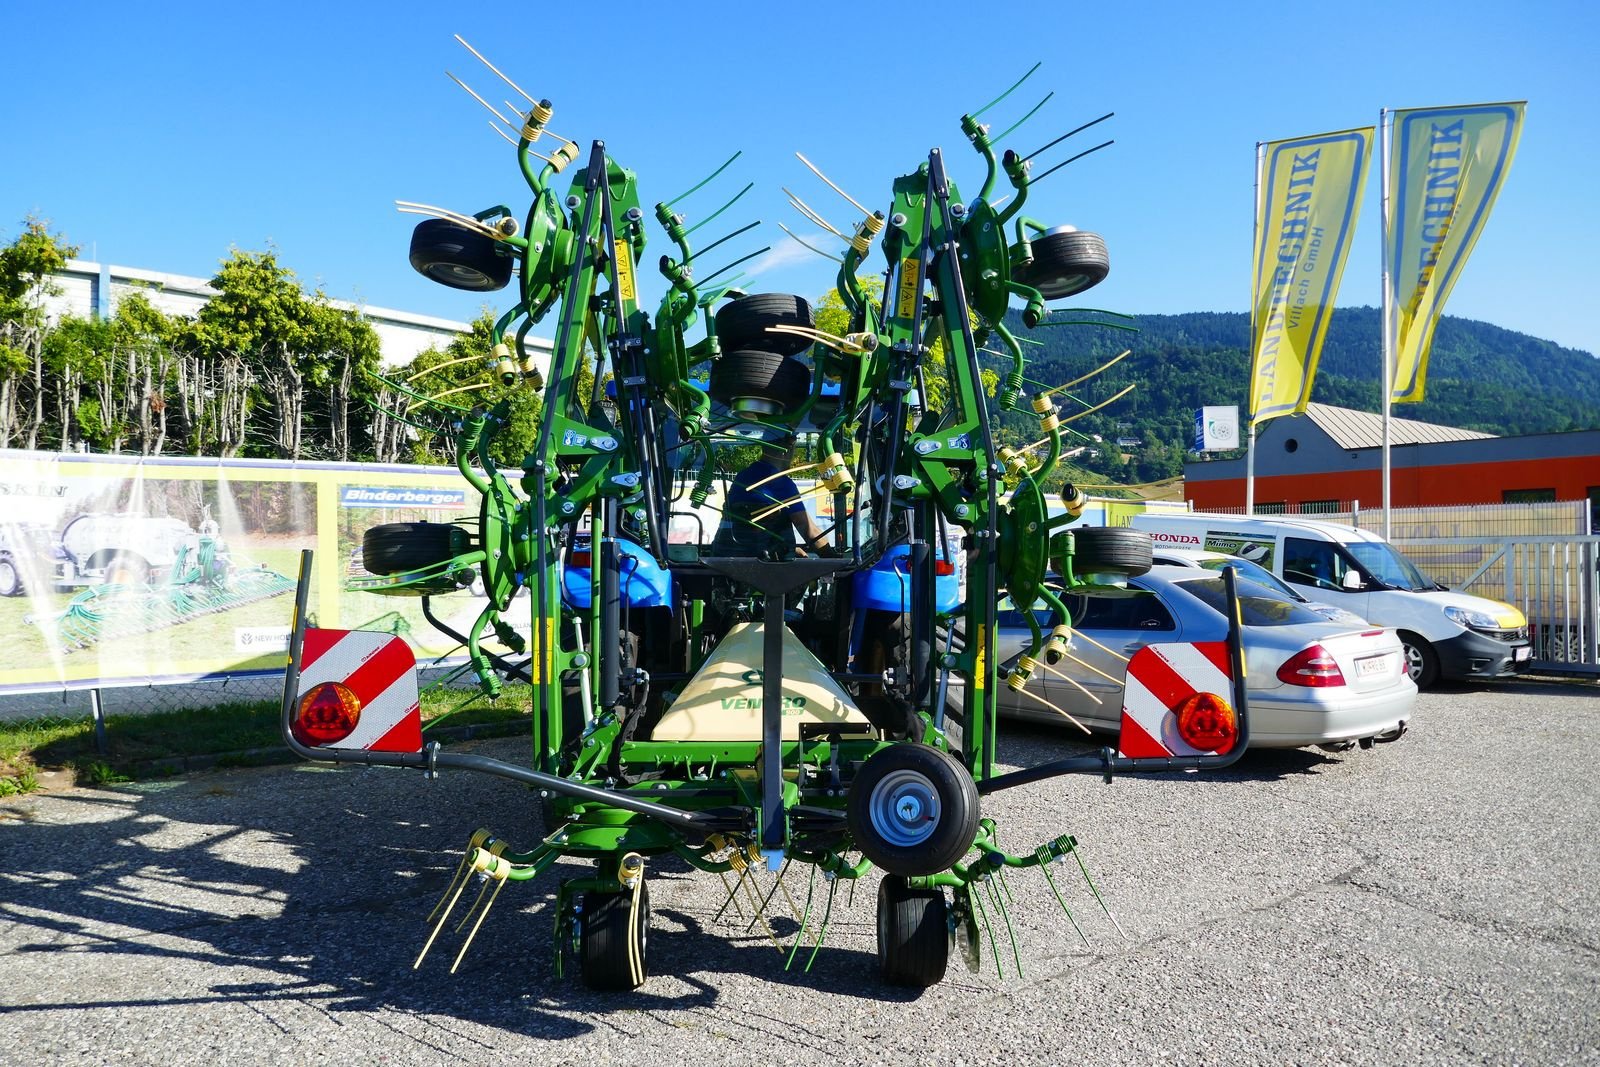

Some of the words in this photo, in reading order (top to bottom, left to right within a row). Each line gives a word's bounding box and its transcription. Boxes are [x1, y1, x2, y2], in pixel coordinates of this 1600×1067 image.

[1288, 279, 1310, 329] Villach
[1303, 226, 1325, 273] GmbH
[345, 489, 462, 504] Binderberger
[1149, 533, 1201, 545] HONDA
[1207, 539, 1237, 548] Miimo
[720, 697, 807, 710] VENRO
